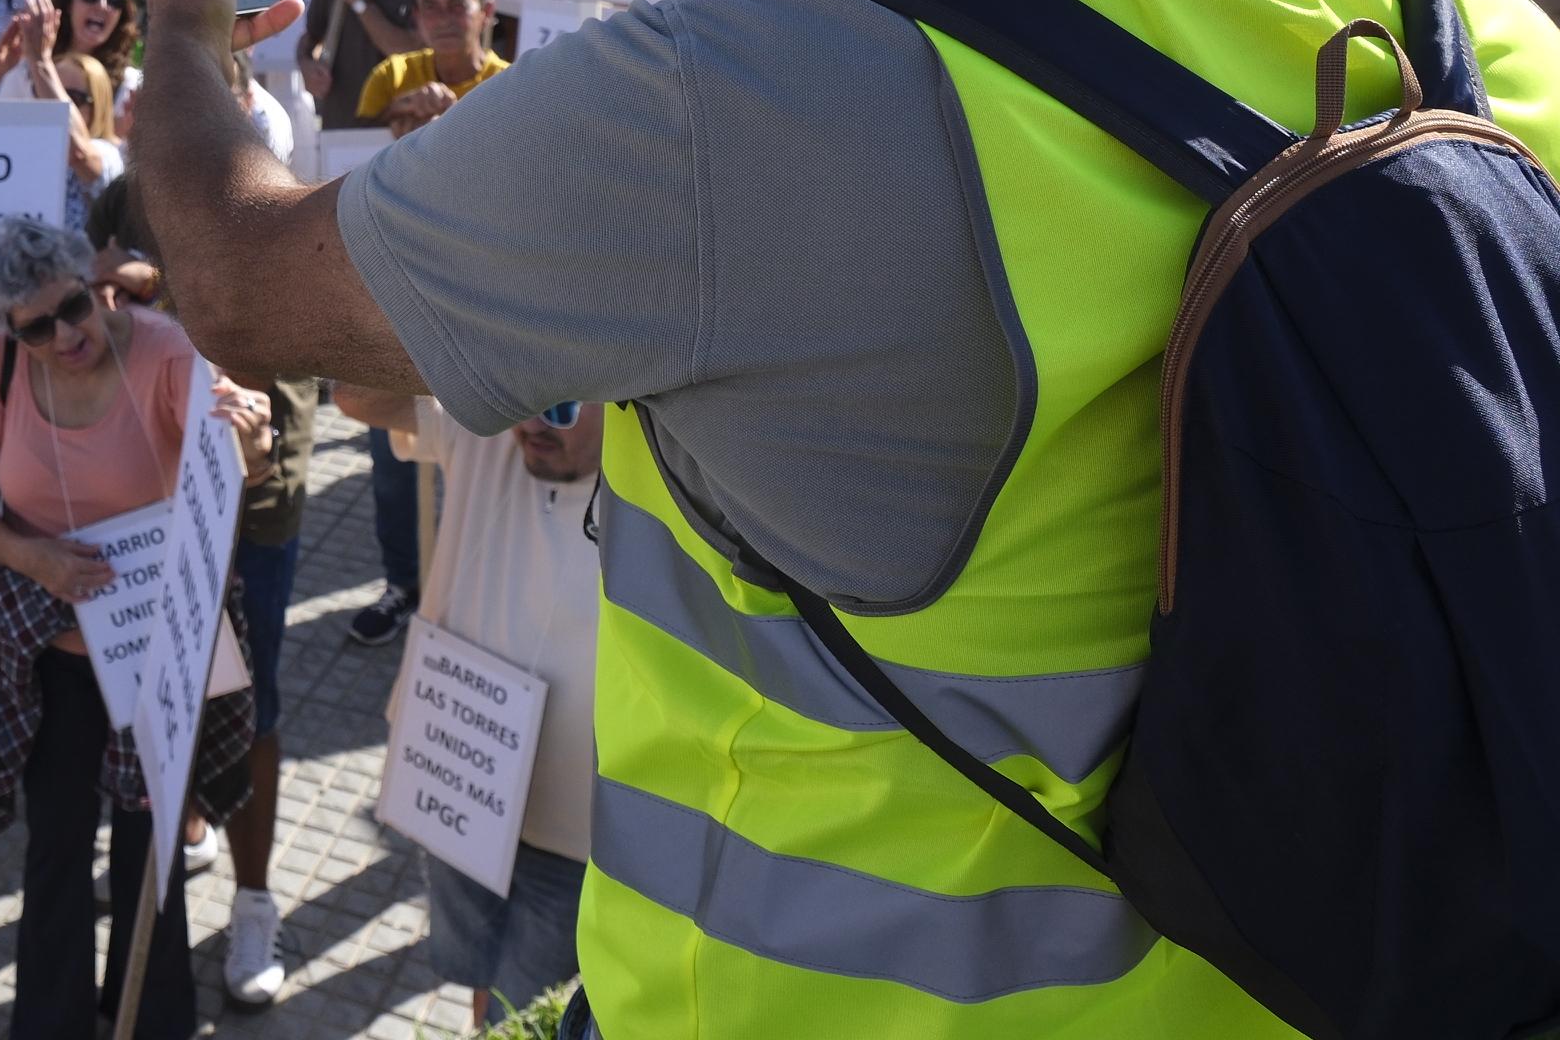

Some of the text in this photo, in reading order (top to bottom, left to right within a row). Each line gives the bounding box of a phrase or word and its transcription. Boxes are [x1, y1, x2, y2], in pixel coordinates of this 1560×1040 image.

[122, 562, 165, 590] TOR
[103, 634, 152, 664] SOM
[438, 656, 509, 706] BARRIO
[415, 679, 519, 752] LAS TORRES
[424, 721, 496, 776] UNIDOS
[403, 745, 506, 818] SOMOS MÁS
[415, 789, 471, 837] LPGC
